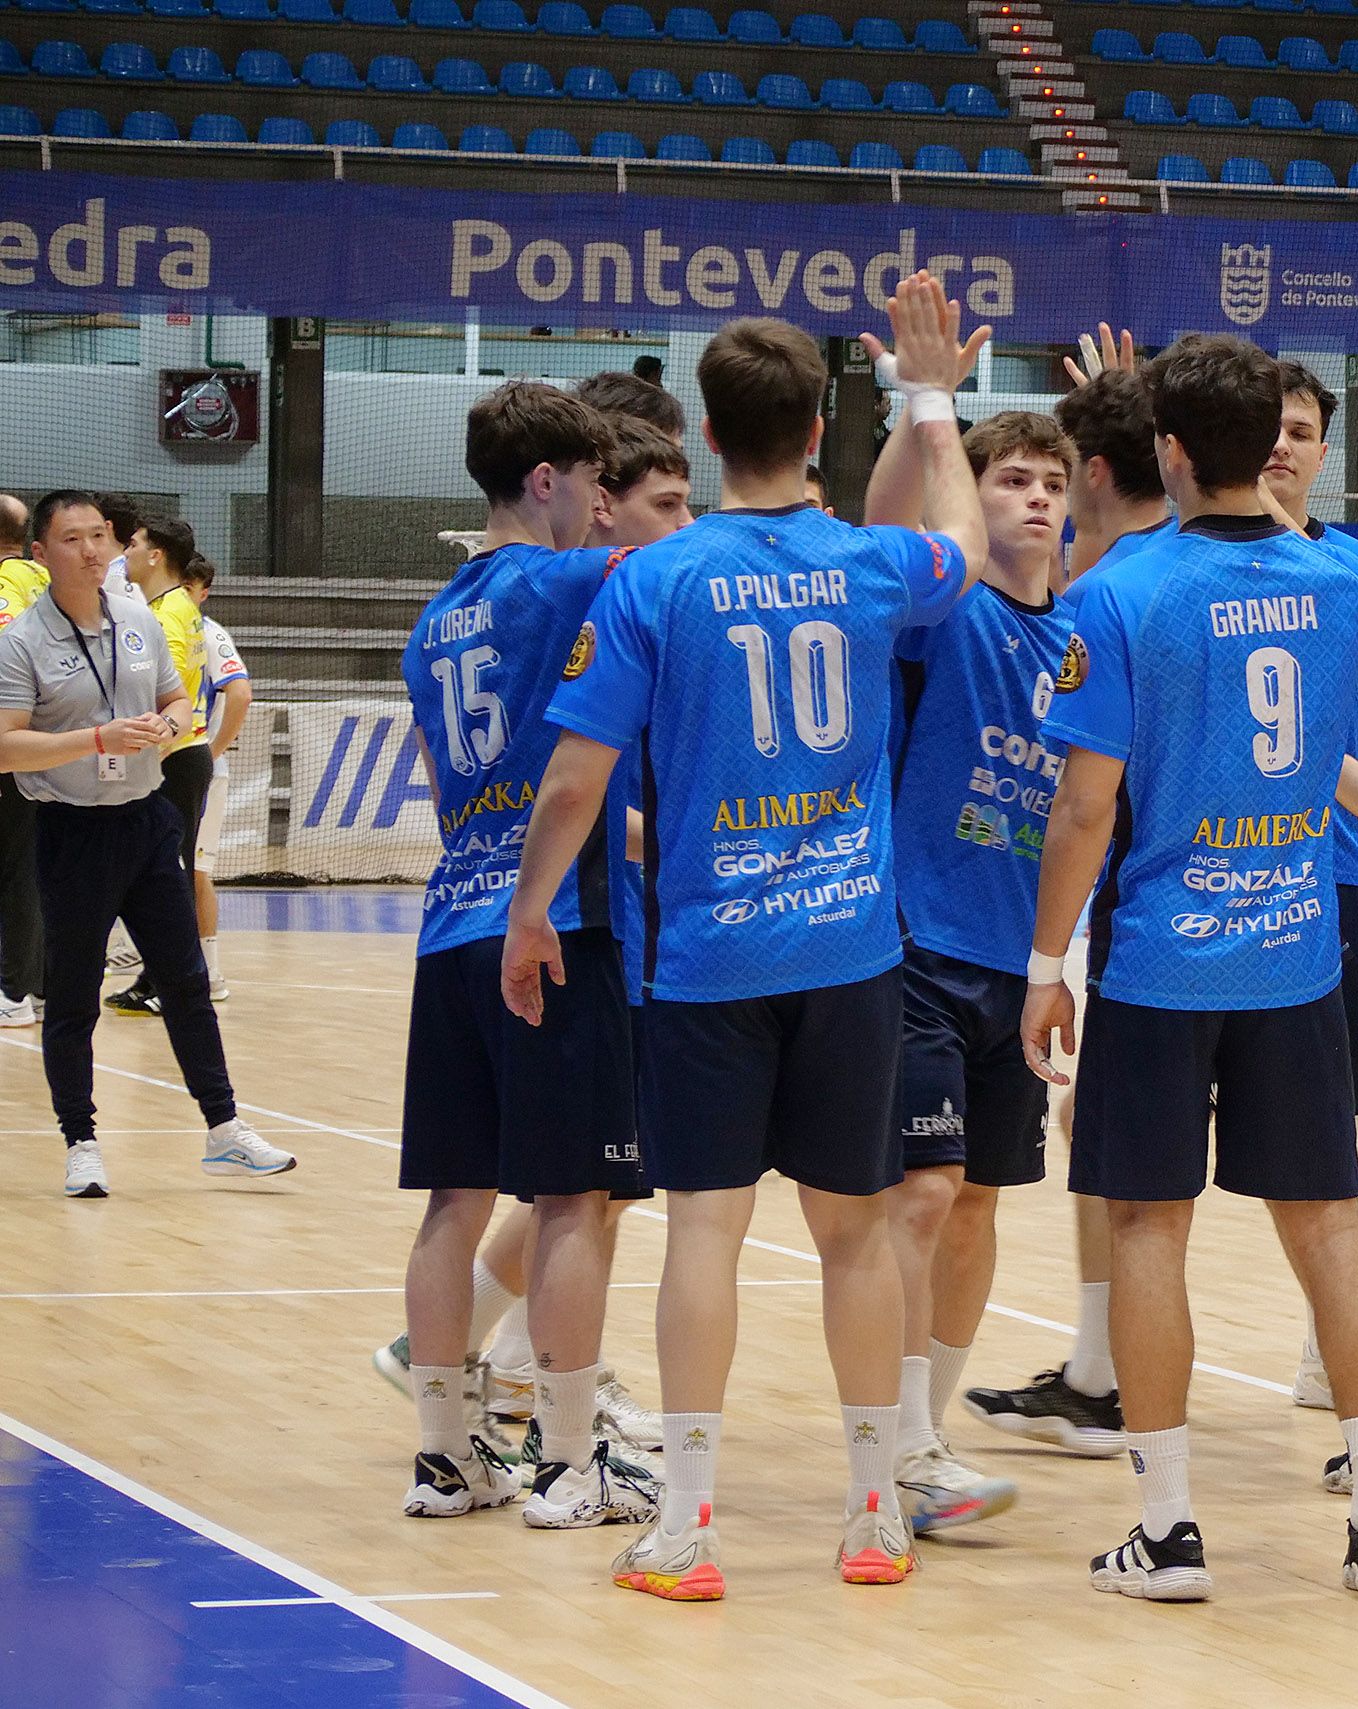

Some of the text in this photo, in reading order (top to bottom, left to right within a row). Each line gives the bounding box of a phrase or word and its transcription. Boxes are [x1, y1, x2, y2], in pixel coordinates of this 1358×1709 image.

[1282, 269, 1352, 288] Concello
[1281, 289, 1301, 306] de
[297, 317, 315, 337] B
[440, 597, 494, 644] UREÑA
[1209, 595, 1319, 638] GRANDA
[727, 621, 852, 759] 10
[431, 645, 512, 777] 15
[1246, 646, 1304, 779] 9
[108, 758, 116, 770] E
[786, 854, 871, 882] AUTOBUSES
[450, 895, 495, 912] Asturdai
[763, 874, 882, 915] HYUNDAI
[807, 907, 857, 925] Asturdai
[604, 1144, 620, 1159] EL
